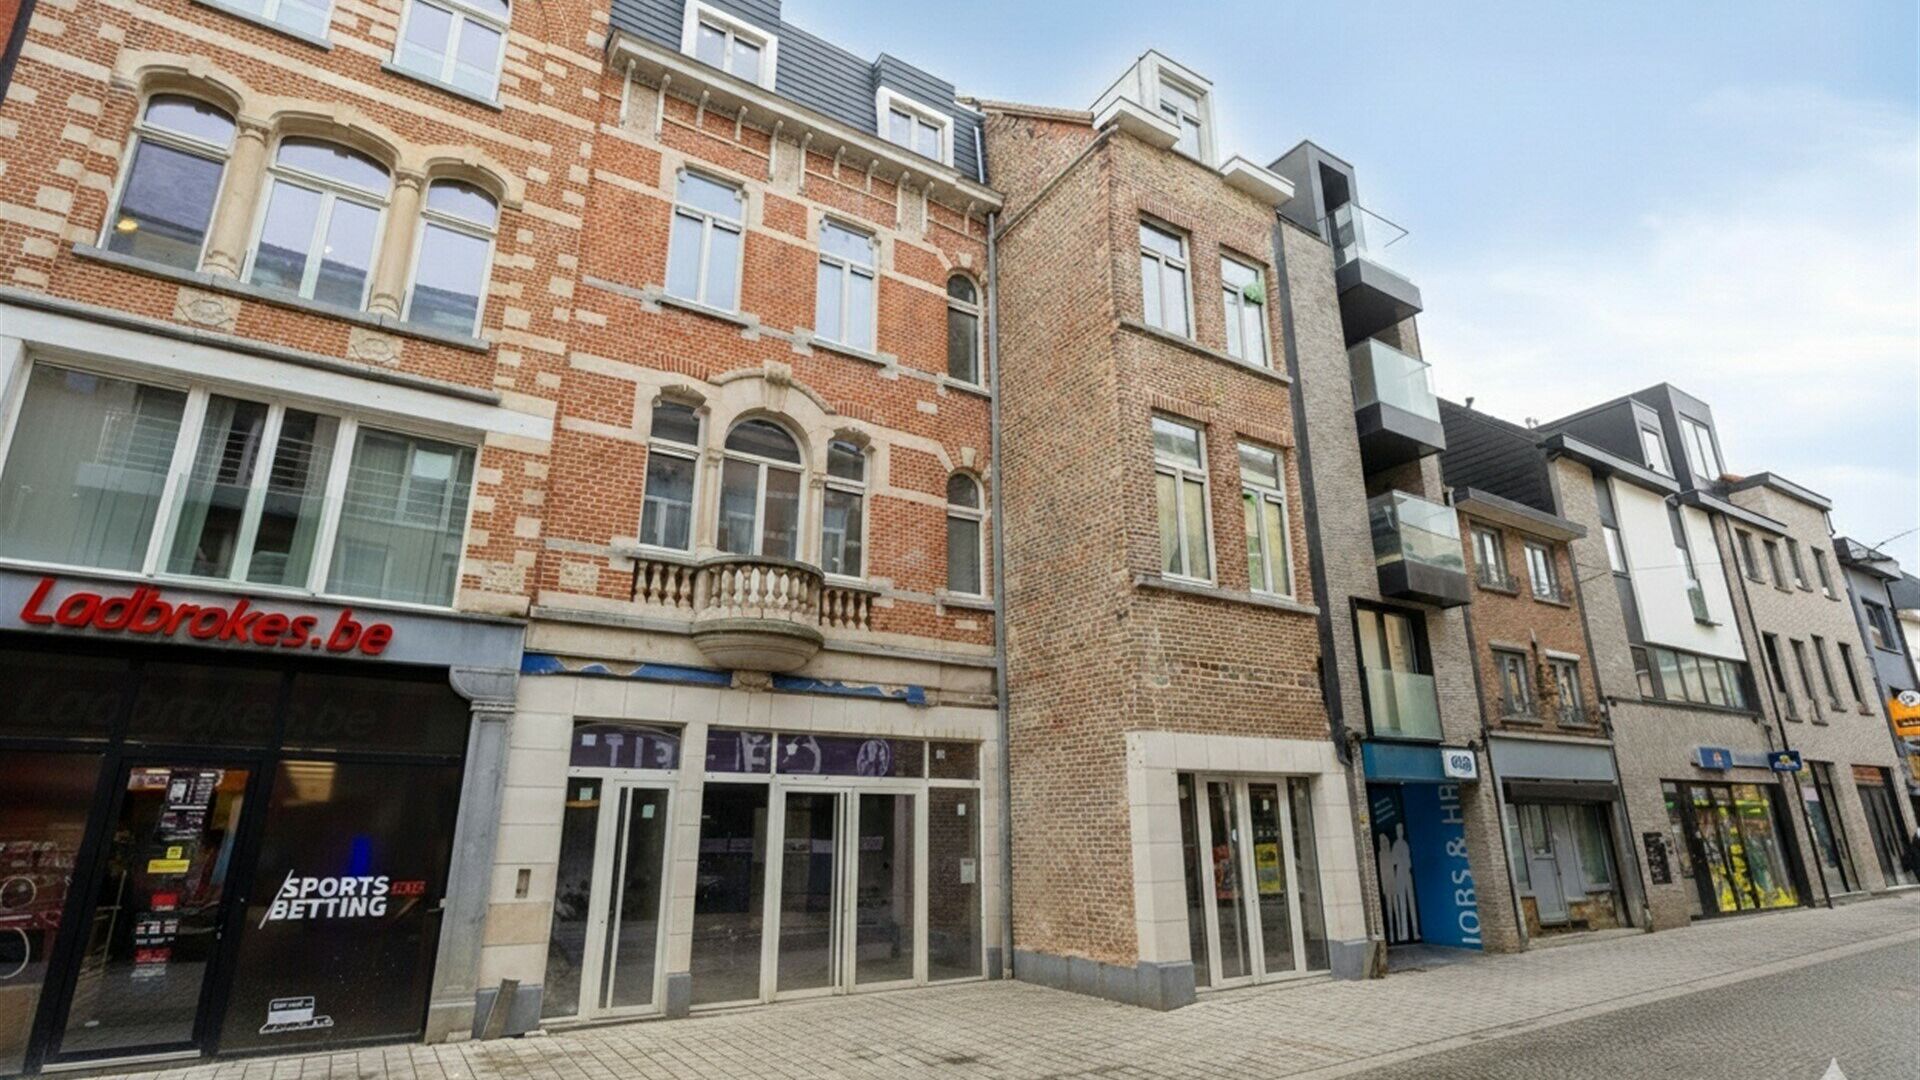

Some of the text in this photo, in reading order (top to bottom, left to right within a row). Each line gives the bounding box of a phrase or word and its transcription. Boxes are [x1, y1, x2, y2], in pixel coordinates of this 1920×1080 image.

[20, 576, 394, 655] Ladbrokes.be
[282, 876, 390, 898] SPORTS
[268, 897, 388, 921] BETTING
